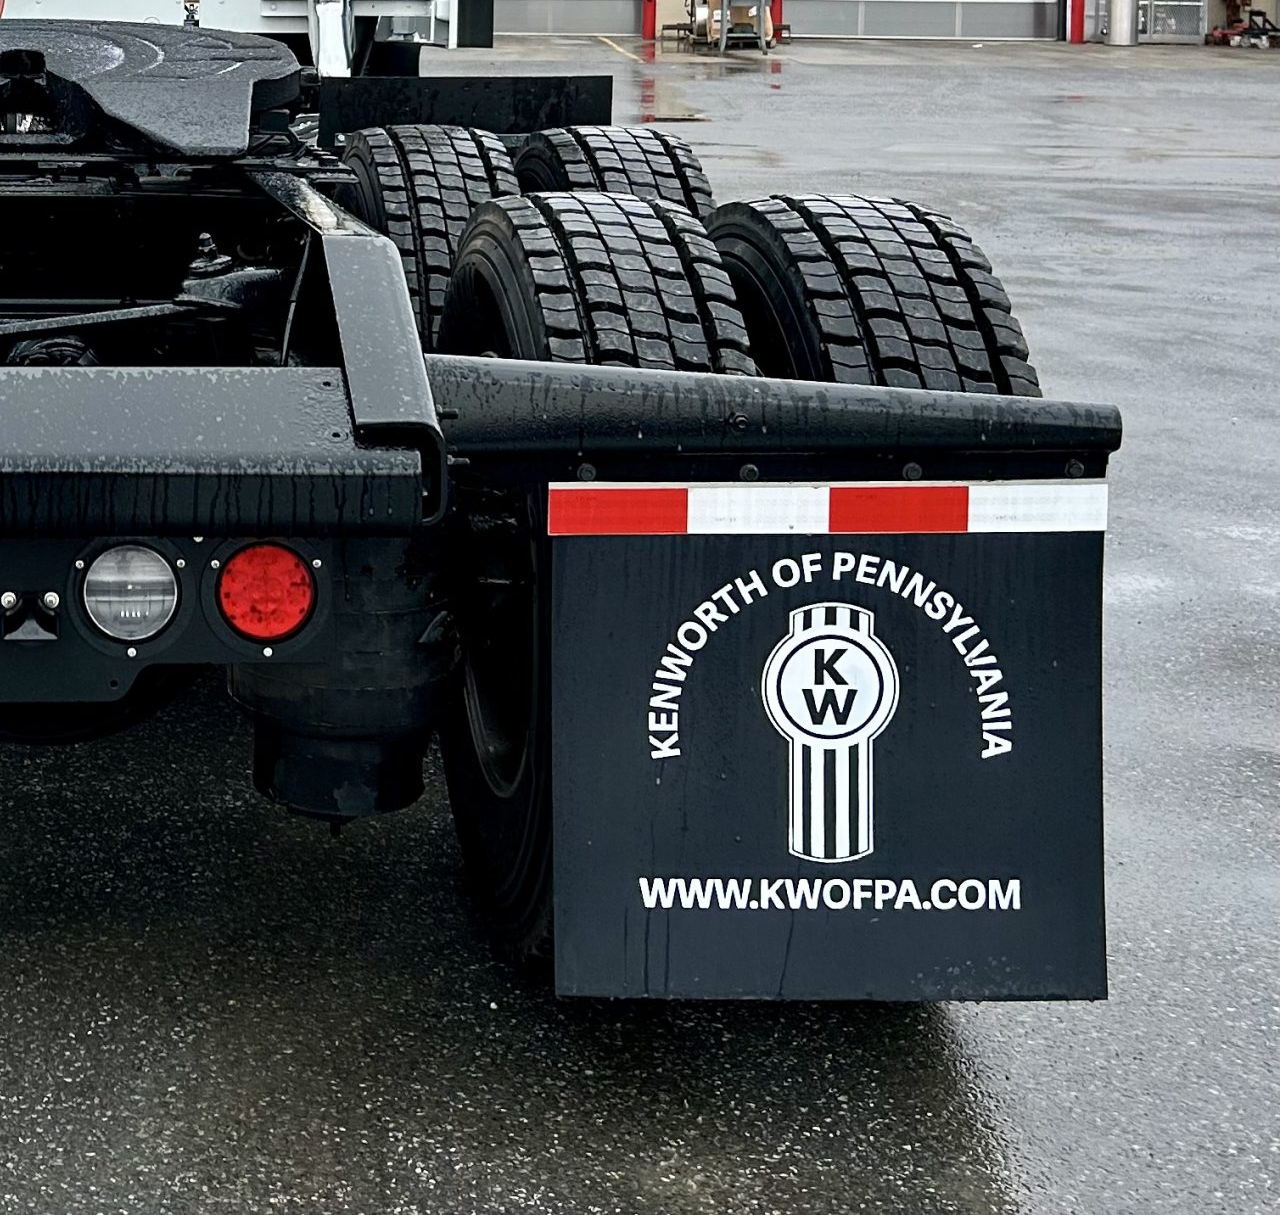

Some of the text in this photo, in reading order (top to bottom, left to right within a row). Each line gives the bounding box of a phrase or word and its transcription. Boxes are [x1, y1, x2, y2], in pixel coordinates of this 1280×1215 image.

[648, 551, 1013, 760] KENWORTH OF PENNSYLVANIA
[814, 648, 849, 686] K
[802, 688, 859, 726] W
[638, 877, 1021, 911] WWW.KWOFPA.COM
